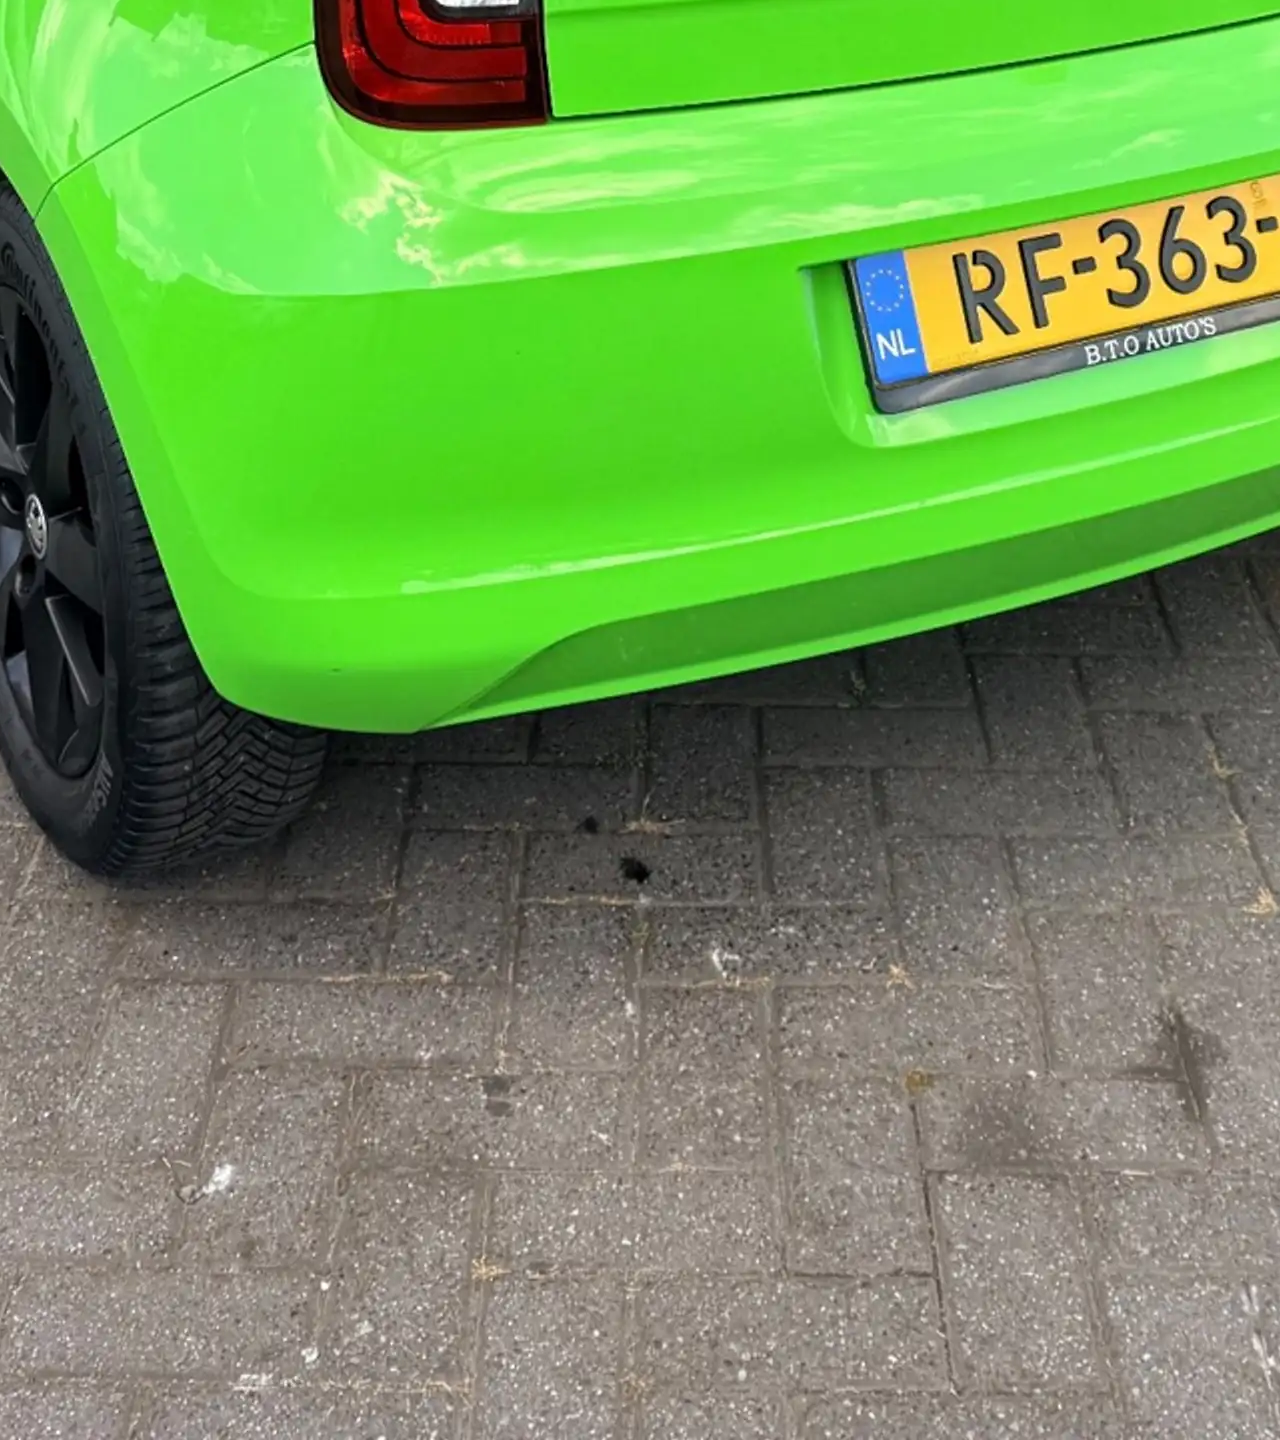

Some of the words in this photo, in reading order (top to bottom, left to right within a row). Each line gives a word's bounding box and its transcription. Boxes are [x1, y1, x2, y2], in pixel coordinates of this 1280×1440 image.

[876, 327, 917, 361] NL
[1083, 335, 1140, 365] B.T.O
[1145, 316, 1217, 352] AUTO'S
